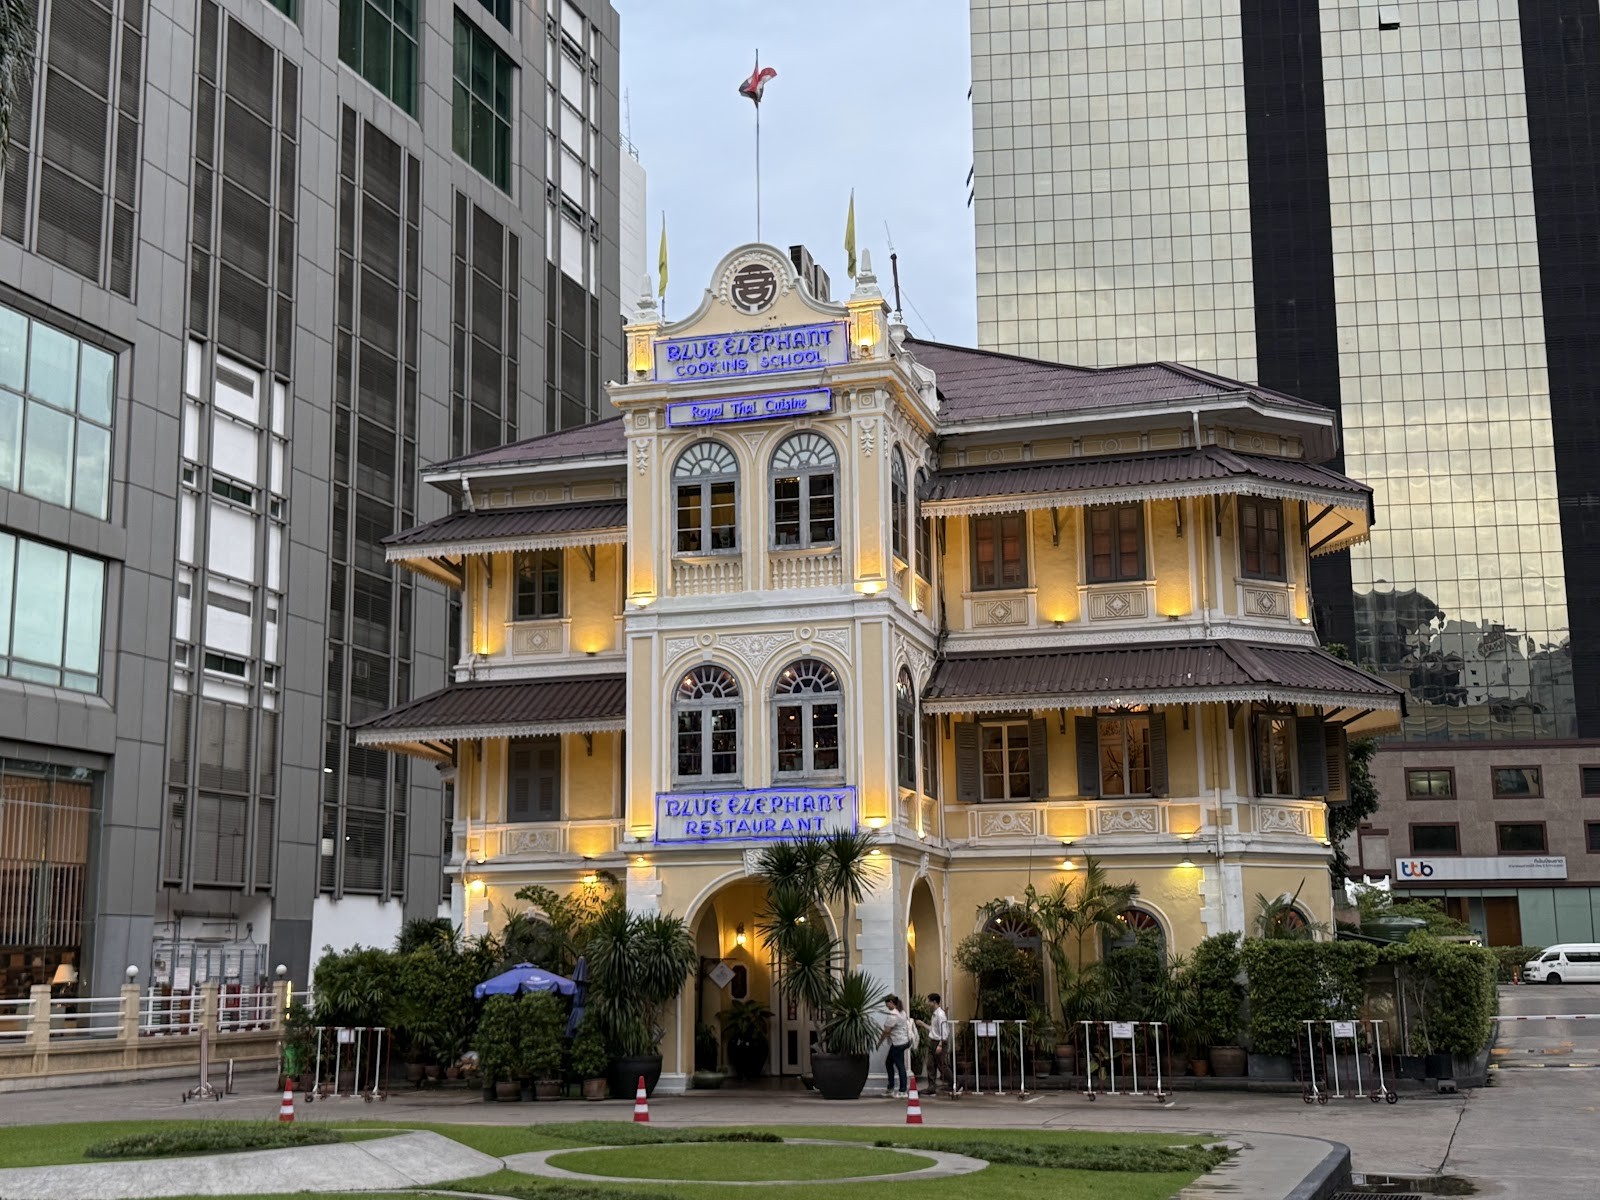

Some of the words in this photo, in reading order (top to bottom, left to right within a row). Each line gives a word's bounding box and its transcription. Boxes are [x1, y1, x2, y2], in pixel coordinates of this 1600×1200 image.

[667, 339, 720, 362] BLUE
[724, 329, 832, 355] ELEPHANT
[676, 358, 748, 376] COOKING
[760, 350, 826, 368] SCHOOL
[691, 404, 724, 421] Royal
[731, 401, 757, 416] Thai
[765, 398, 807, 413] Cuisine
[665, 796, 723, 817] BLUE
[727, 793, 847, 815] ELEPHANT
[685, 815, 826, 835] RESTAURANT
[1401, 861, 1434, 877] ttb
